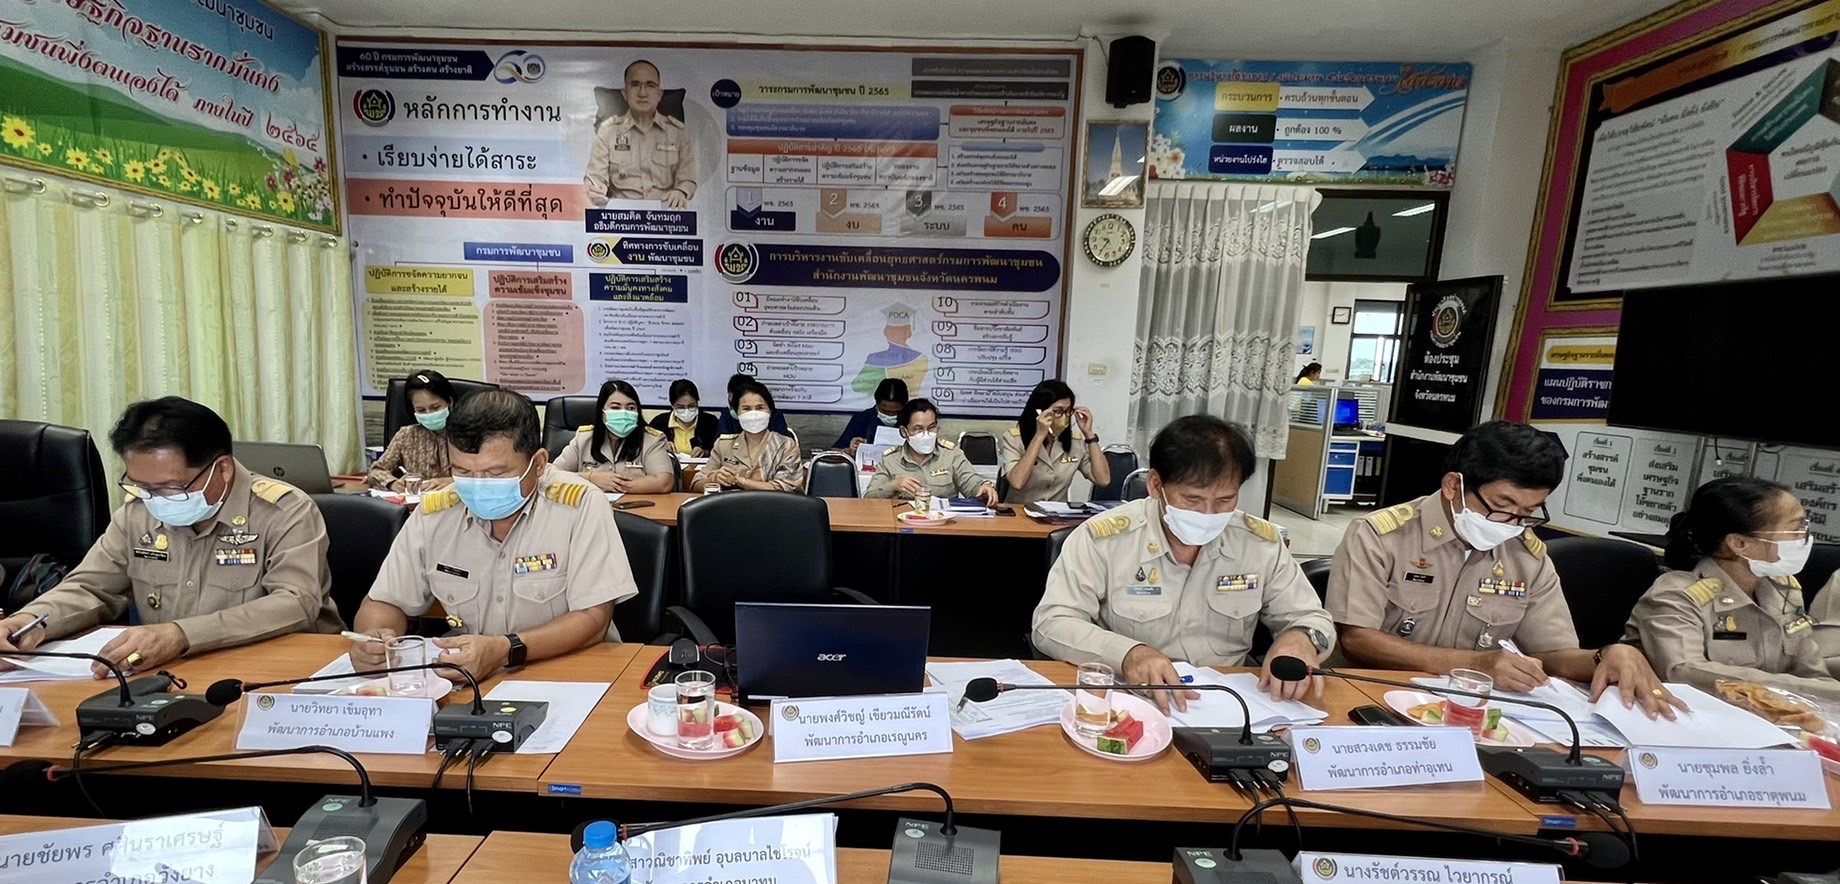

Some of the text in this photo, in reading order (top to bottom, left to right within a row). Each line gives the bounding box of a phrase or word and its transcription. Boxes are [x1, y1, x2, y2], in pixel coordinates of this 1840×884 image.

[0, 19, 189, 103] มชนพึ่งตนเองได้
[758, 84, 889, 97] วาระกรมการพัฒนาชุมชน ปี 2565
[1221, 91, 1272, 103] กระบวนการ
[1285, 90, 1359, 104] ครบถ้วนทุกขั้นตอน
[403, 95, 561, 122] หลักการทำงาน
[1229, 123, 1258, 135] ผลงาน
[1284, 124, 1311, 137] ถูกต้อง
[1314, 126, 1331, 135] 100
[378, 146, 538, 170] เรียบง่ายได้สาระ
[1213, 154, 1268, 165] หน่วยงานโปร่งใส
[1277, 156, 1325, 168] ตรวจสอบได้
[379, 184, 563, 217] ทำปัจจุบันให้ดีที่สุด
[829, 193, 838, 205] 2
[914, 194, 923, 207] 3
[998, 196, 1007, 209] 4
[755, 215, 774, 227] งาน
[924, 220, 950, 231] ระบบ
[1012, 221, 1027, 231] คน
[594, 222, 689, 234] อธิบดีกรมการพัฒนาชุมชน
[476, 244, 561, 259] กรมการพัฒนาชุมชน
[622, 240, 699, 251] ทิศทางการขับเคลื่อน
[627, 253, 695, 265] งาน พัฒนาชุมชน
[812, 269, 998, 287] สำนักงานพัฒนาชุมชนจังหวัดนครพนม
[736, 292, 750, 302] 01
[938, 297, 953, 307] 10
[737, 316, 753, 326] 02
[937, 321, 953, 332] 09
[737, 339, 753, 349] 03
[936, 343, 952, 354] 08
[1424, 350, 1460, 368] ห้องประชุม
[739, 362, 754, 372] 04
[937, 367, 953, 377] 07
[1410, 369, 1468, 385] สำนักงานพัฒนาชุมชน
[1544, 376, 1612, 391] แผนปฏิบัติราชก
[935, 387, 951, 398] 06
[1415, 389, 1456, 402] จังหวัดนครพนม
[1540, 396, 1609, 408] ของกรมการพัฒ
[1582, 451, 1619, 463] สร้างสรรค์
[1588, 465, 1608, 475] ชุมชน
[1649, 459, 1679, 472] ส่งเสริม
[1643, 473, 1679, 486] เศรษฐกิจ
[1642, 487, 1674, 499] ฐานราก
[1633, 510, 1670, 527] อย่างสมดุ
[817, 653, 847, 662] acer
[291, 701, 382, 720] นายวิทยา เข็มอุทา
[799, 709, 865, 725] นายพงศ์วิชญ์
[267, 722, 395, 739] พัฒนาการอำเภอบ้านแพง
[804, 730, 928, 747] พัฒนาการอำเภอเรณูนคร
[1395, 735, 1437, 752] ธรรมชัย
[1328, 761, 1453, 779] พัฒนาการอำเภอท่าอุเทน
[1677, 756, 1775, 779] นายชุมพล ยิ่งล้ำ
[1659, 785, 1807, 806] พัฒนาการอำเภอธาตุพนม
[905, 822, 929, 830] NPE
[0, 842, 92, 869] นายชัยพร
[630, 848, 712, 869] สาวณิชาทิพย์
[1344, 861, 1513, 884] นางรัชต์วรรณ ไวยากรณ์
